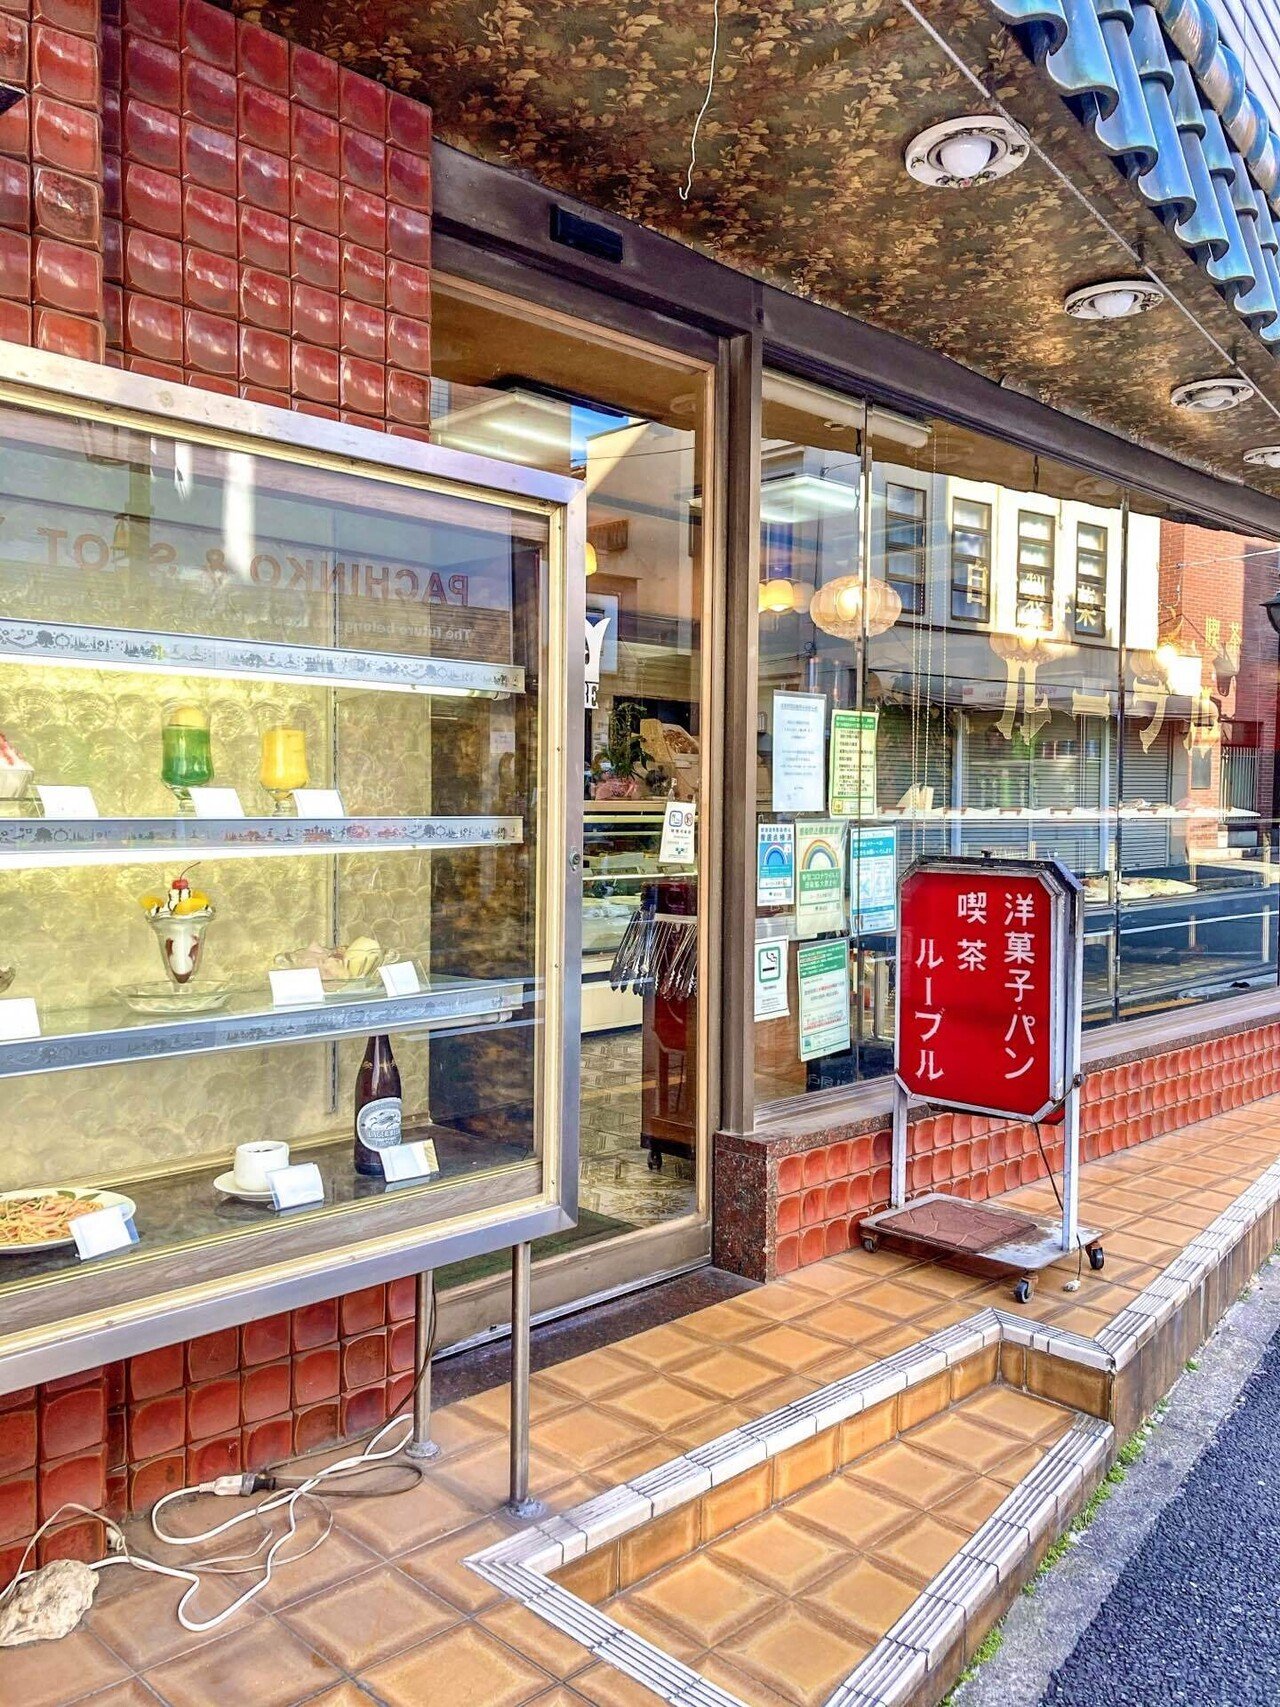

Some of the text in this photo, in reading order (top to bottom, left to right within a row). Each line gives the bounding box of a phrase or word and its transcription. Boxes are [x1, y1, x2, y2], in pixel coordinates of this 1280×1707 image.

[957, 891, 988, 972] 喫茶
[1004, 893, 1035, 1080] 洋菓子・パン
[914, 938, 945, 1080] ルーブル
